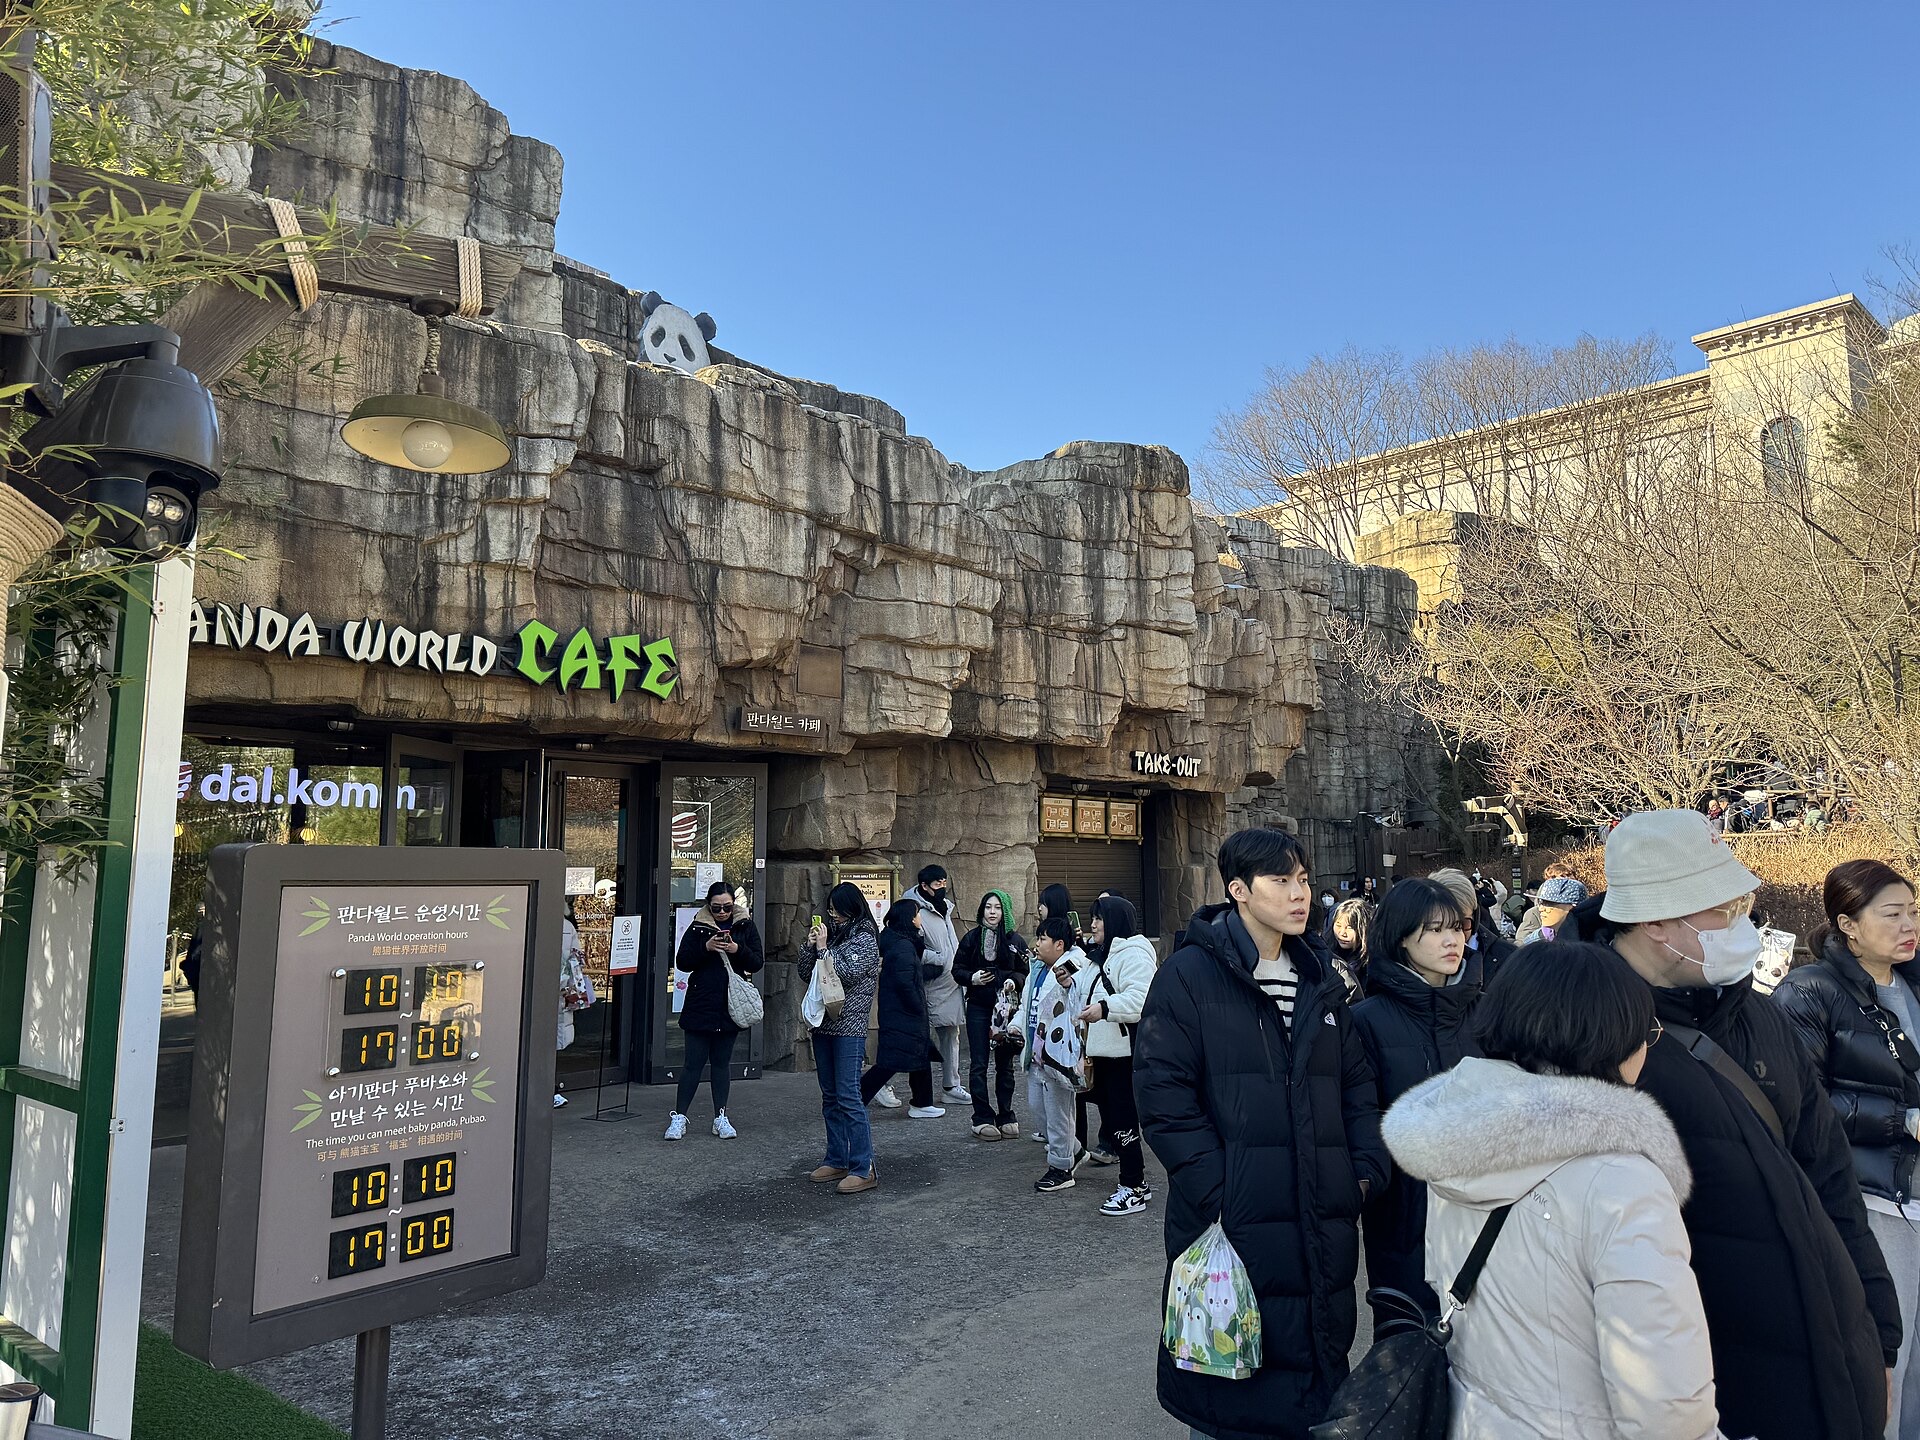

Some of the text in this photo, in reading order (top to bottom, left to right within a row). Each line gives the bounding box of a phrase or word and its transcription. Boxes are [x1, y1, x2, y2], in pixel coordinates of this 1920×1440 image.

[190, 597, 682, 704] ANDA WORLD CAFE
[746, 712, 821, 733] 판다월드 카페
[1134, 751, 1202, 778] TAKE-OUT
[336, 903, 482, 925] 판다월드 운영시간
[348, 930, 469, 943] Panda World operation hours
[328, 1070, 468, 1104] 아기판다 푸바오와
[330, 1093, 465, 1129] 만날 수 있는 시간
[305, 1114, 487, 1149] The time you can meet baby panda, Pubao.
